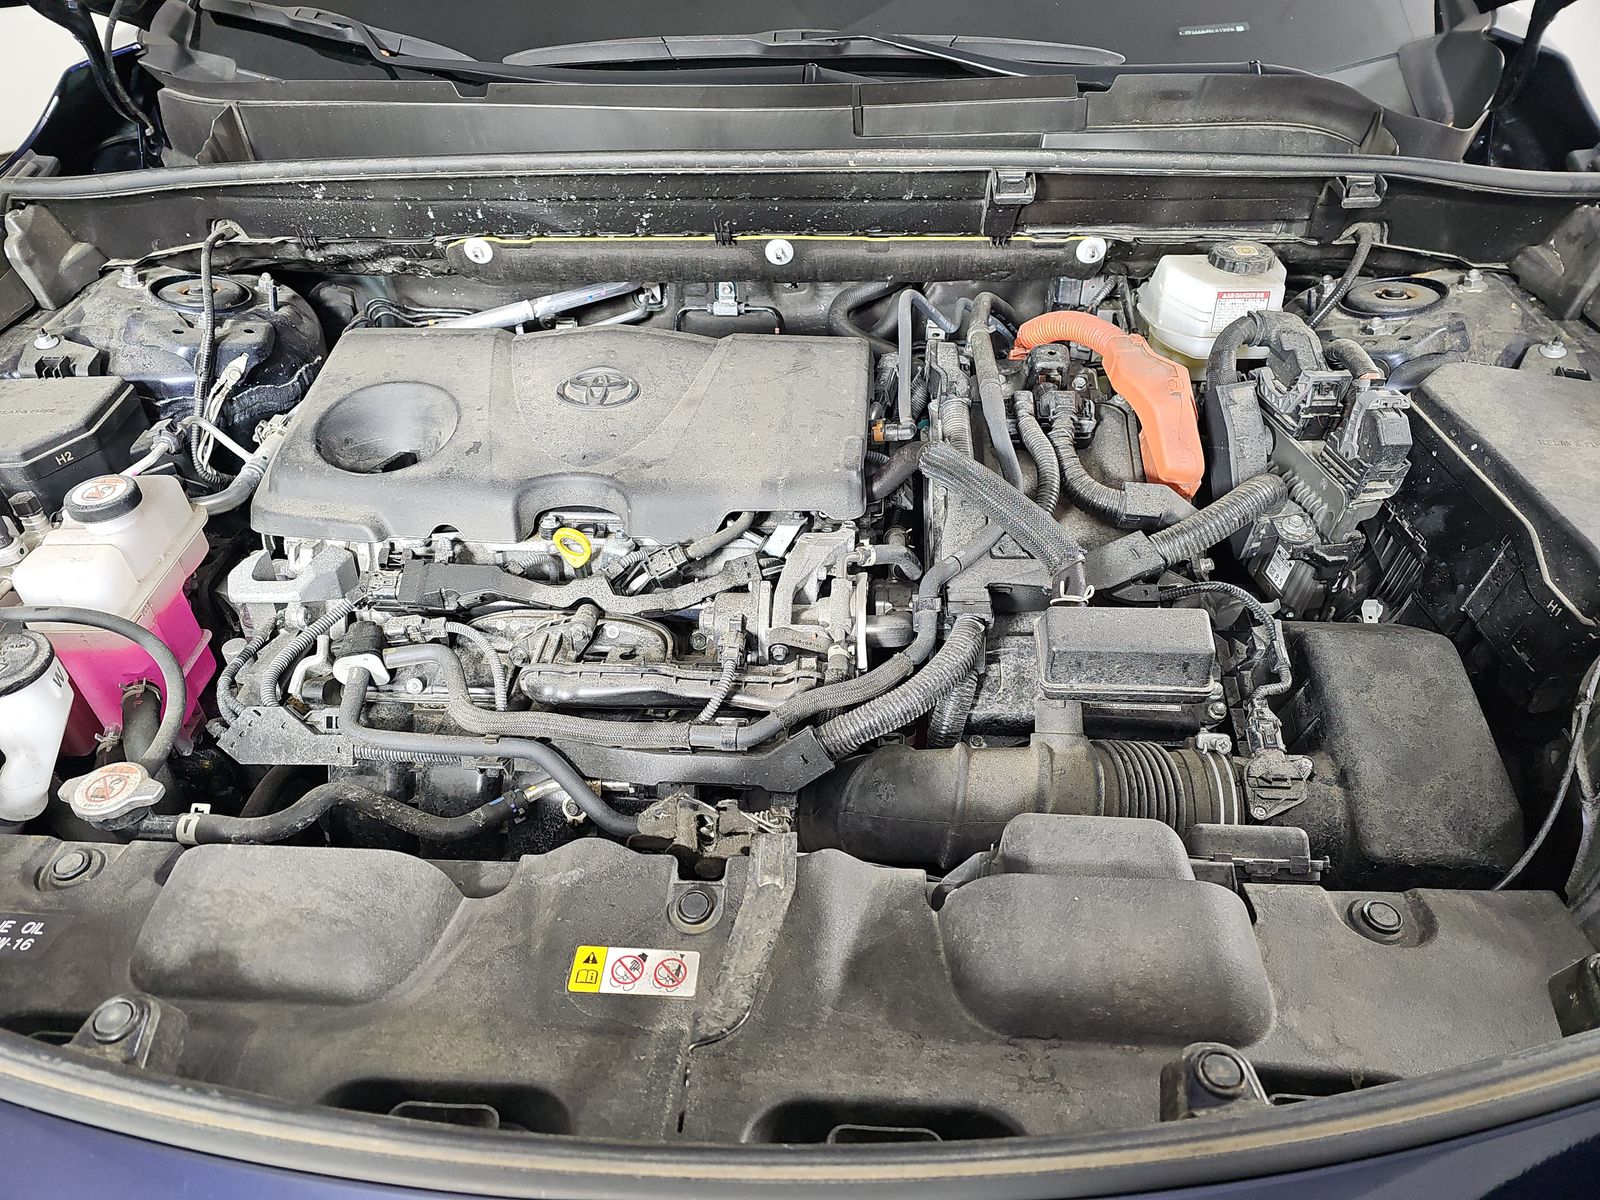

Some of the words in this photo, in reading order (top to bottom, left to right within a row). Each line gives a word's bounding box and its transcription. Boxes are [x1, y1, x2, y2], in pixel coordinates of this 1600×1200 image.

[55, 451, 74, 466] H2
[1546, 599, 1563, 617] H1
[21, 921, 44, 935] OIL
